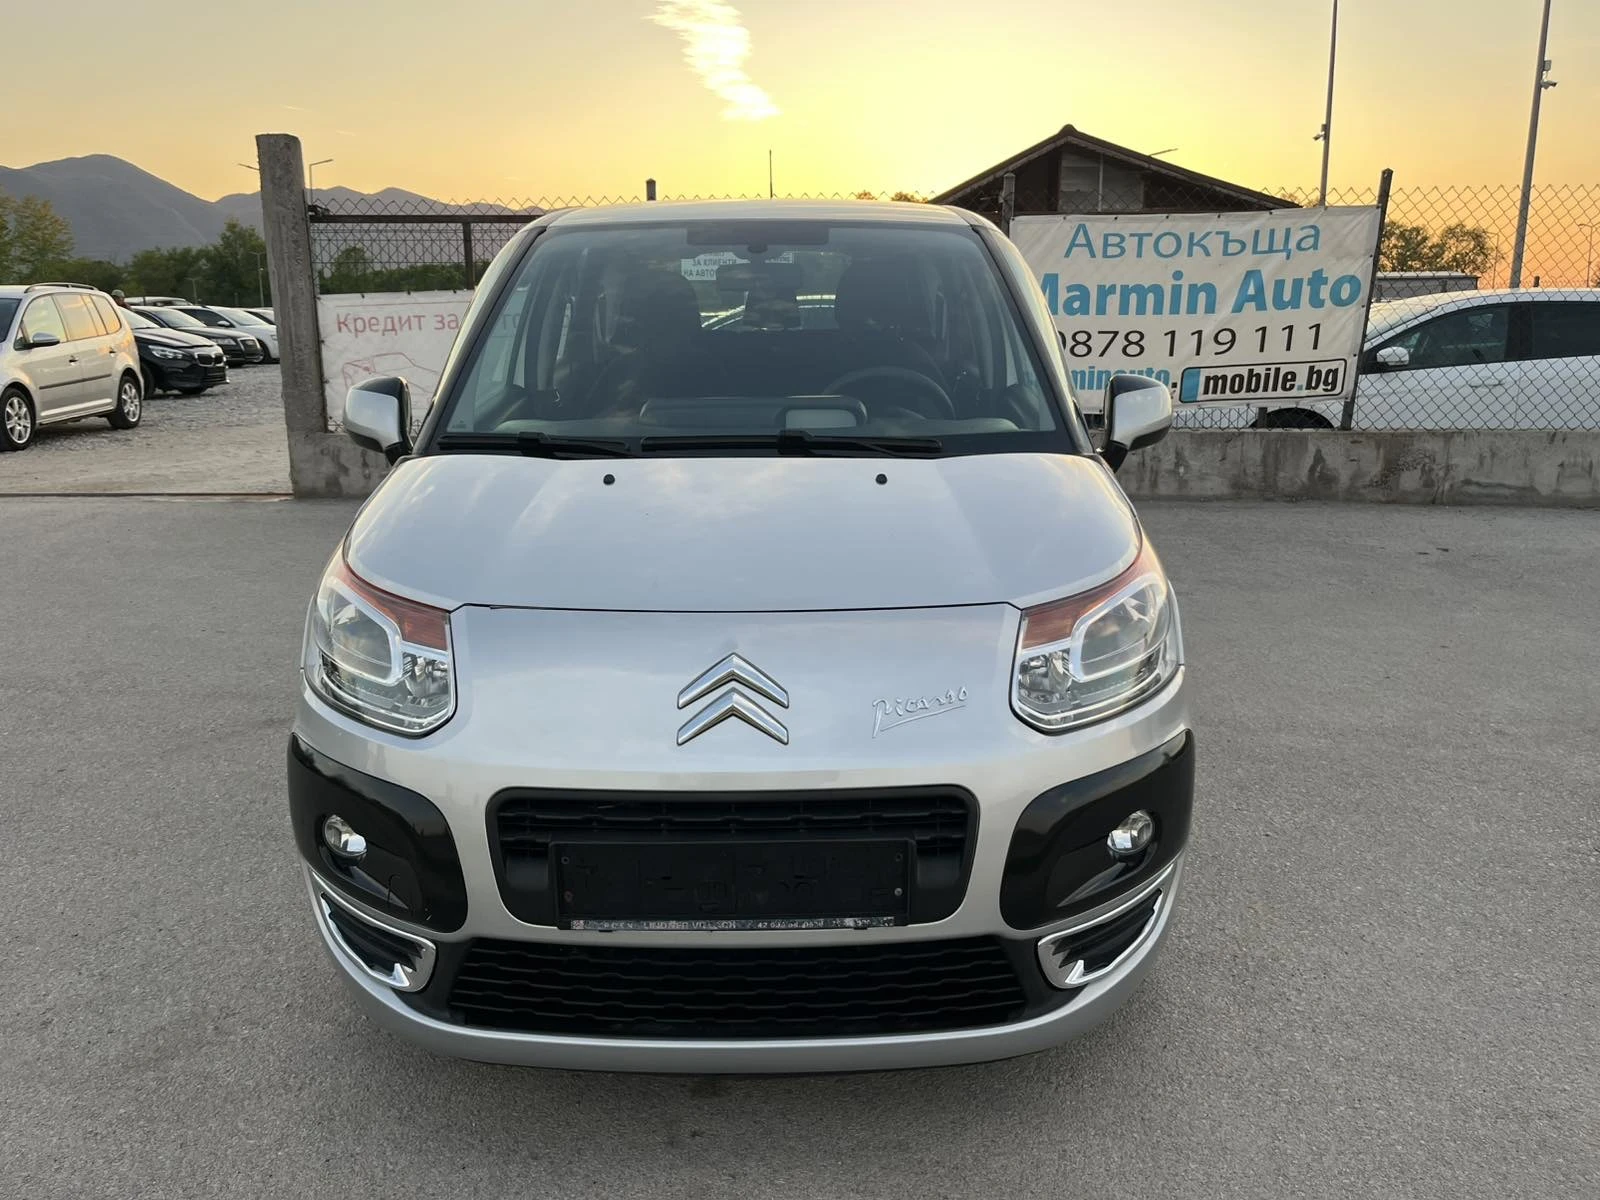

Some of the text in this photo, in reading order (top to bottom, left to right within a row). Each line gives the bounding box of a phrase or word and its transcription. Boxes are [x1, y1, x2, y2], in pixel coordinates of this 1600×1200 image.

[1063, 222, 1321, 260] Автокъща
[1230, 268, 1362, 315] Auto
[336, 313, 460, 338] Кредит за
[1164, 327, 1237, 357] 119
[1254, 322, 1322, 353] 111
[1202, 365, 1340, 396] mobile.bg
